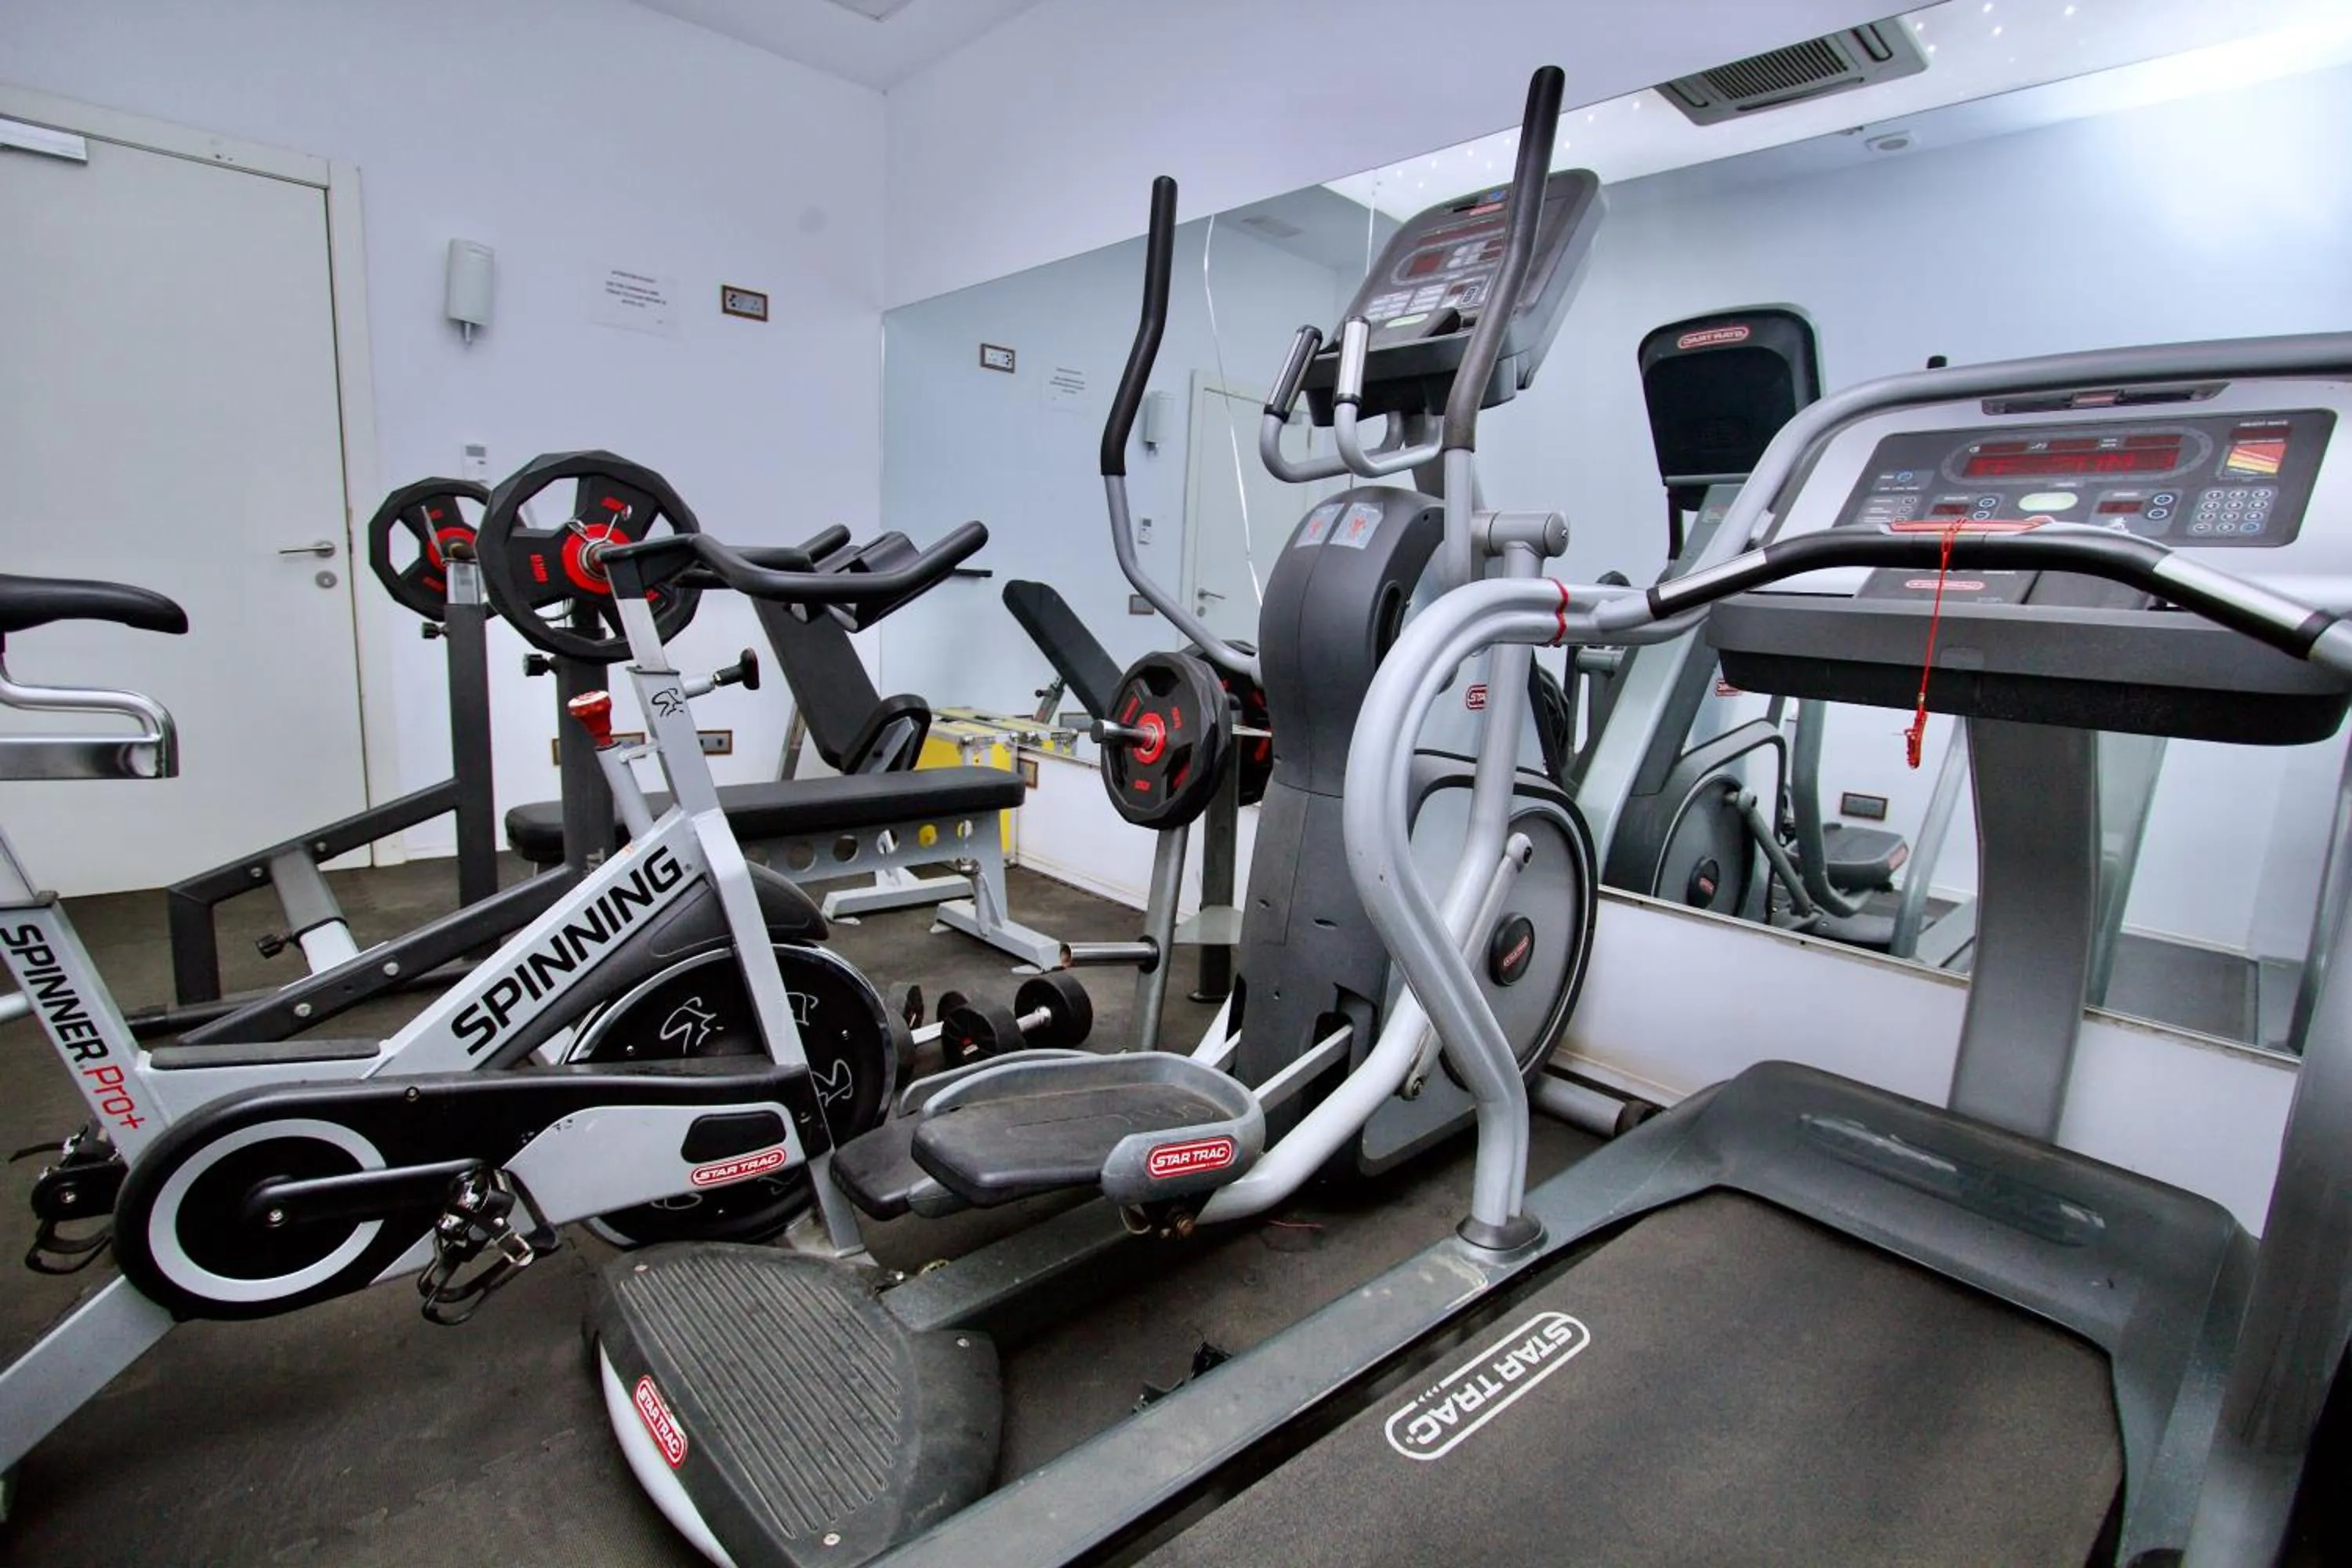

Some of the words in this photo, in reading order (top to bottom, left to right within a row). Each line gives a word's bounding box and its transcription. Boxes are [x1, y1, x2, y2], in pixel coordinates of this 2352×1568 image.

[451, 845, 684, 1056] SPINNING
[0, 924, 110, 1063] SPINNER
[82, 1065, 146, 1130] Pro+
[699, 1166, 739, 1180] STAR
[739, 1153, 779, 1171] TRAC
[1156, 1152, 1190, 1167] STAR
[1191, 1147, 1226, 1162] TRAC
[1492, 1316, 1573, 1382] STAR
[637, 1387, 660, 1421] STAR
[655, 1416, 681, 1454] TRAC
[1406, 1374, 1505, 1446] TRAC
